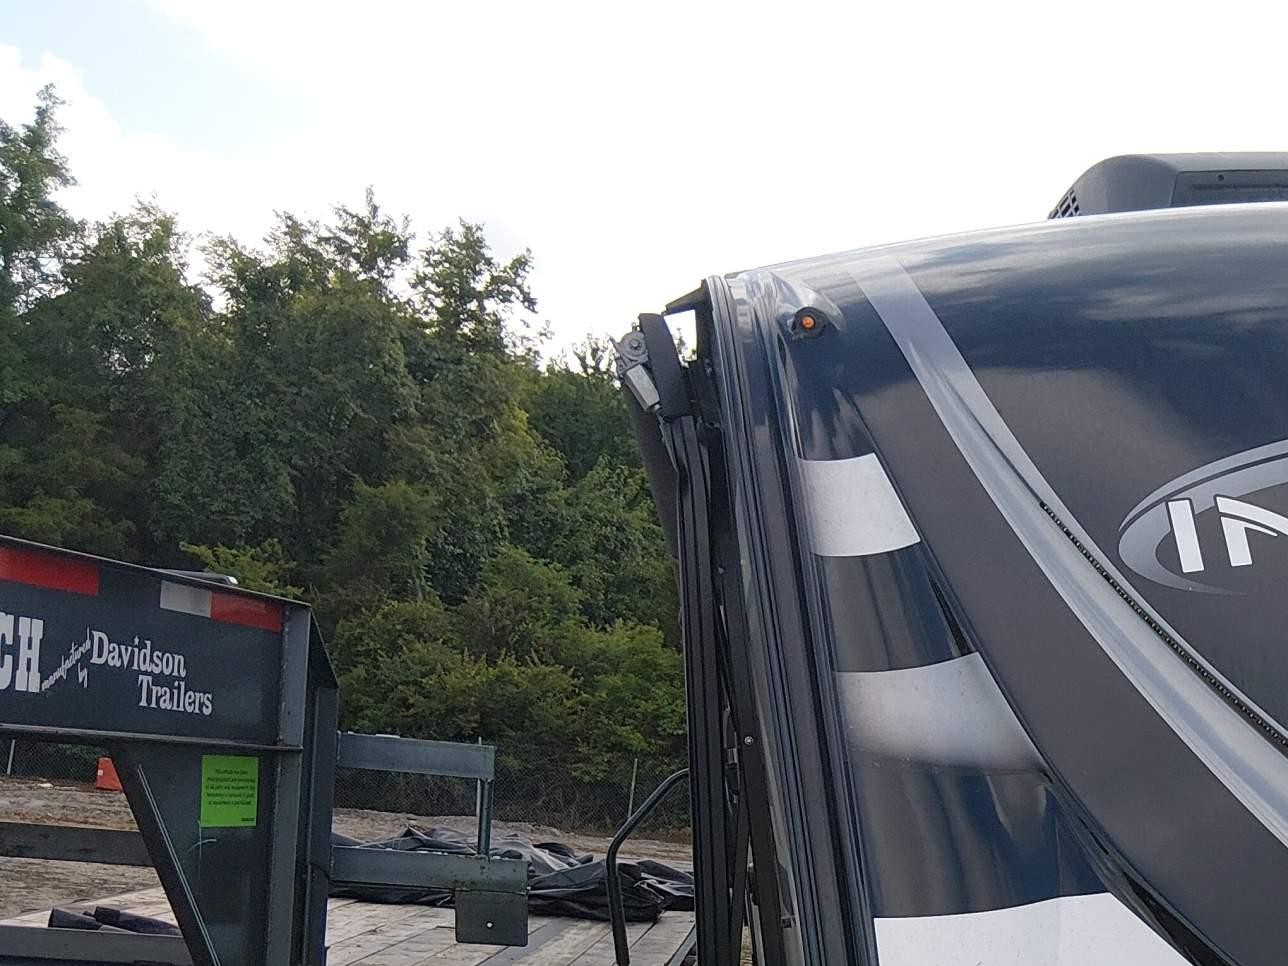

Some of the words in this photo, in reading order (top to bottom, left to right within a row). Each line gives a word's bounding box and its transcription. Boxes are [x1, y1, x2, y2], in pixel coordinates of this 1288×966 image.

[91, 630, 187, 679] Davidson
[77, 664, 89, 689] by
[138, 674, 213, 716] Trailers
